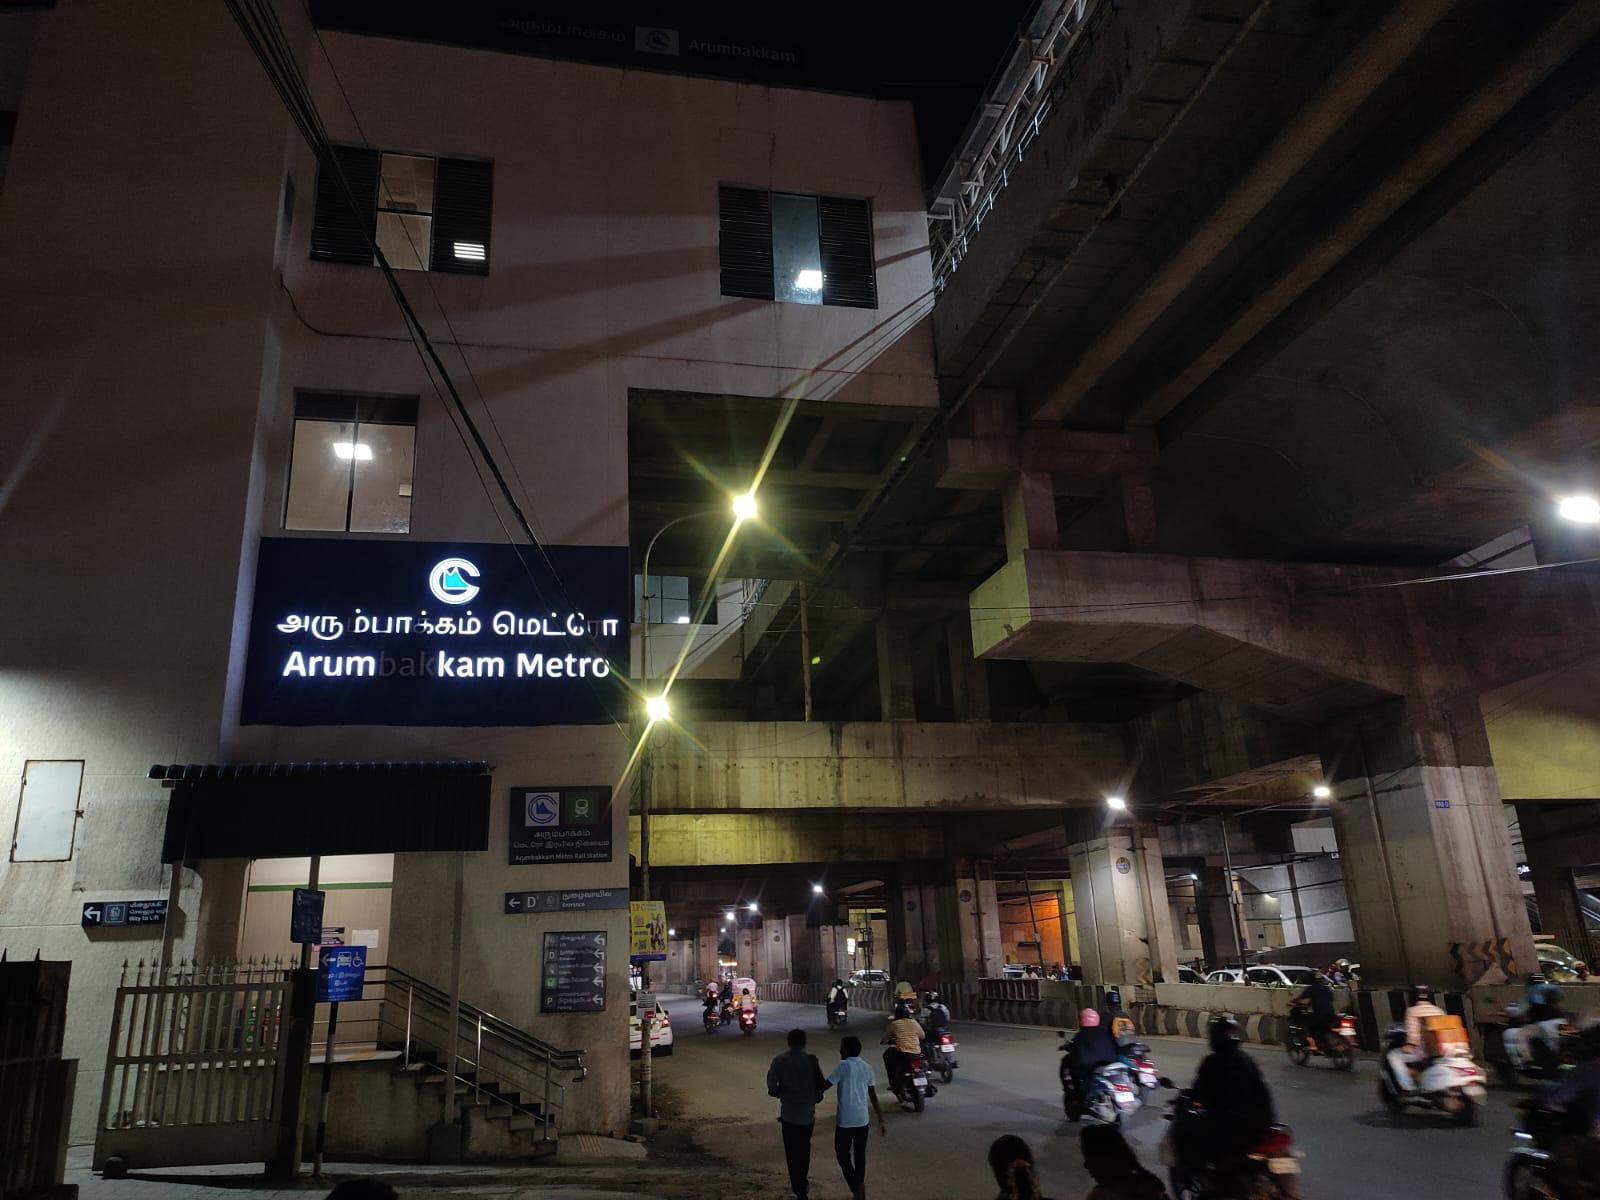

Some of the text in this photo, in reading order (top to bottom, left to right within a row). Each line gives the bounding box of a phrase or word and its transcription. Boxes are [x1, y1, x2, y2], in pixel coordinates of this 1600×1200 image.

[688, 38, 797, 63] Arumbakkam
[276, 608, 620, 641] அரும்பாக்கம் மெட்ரோ
[282, 650, 611, 679] Arumbakkam Metro
[527, 896, 537, 908] D
